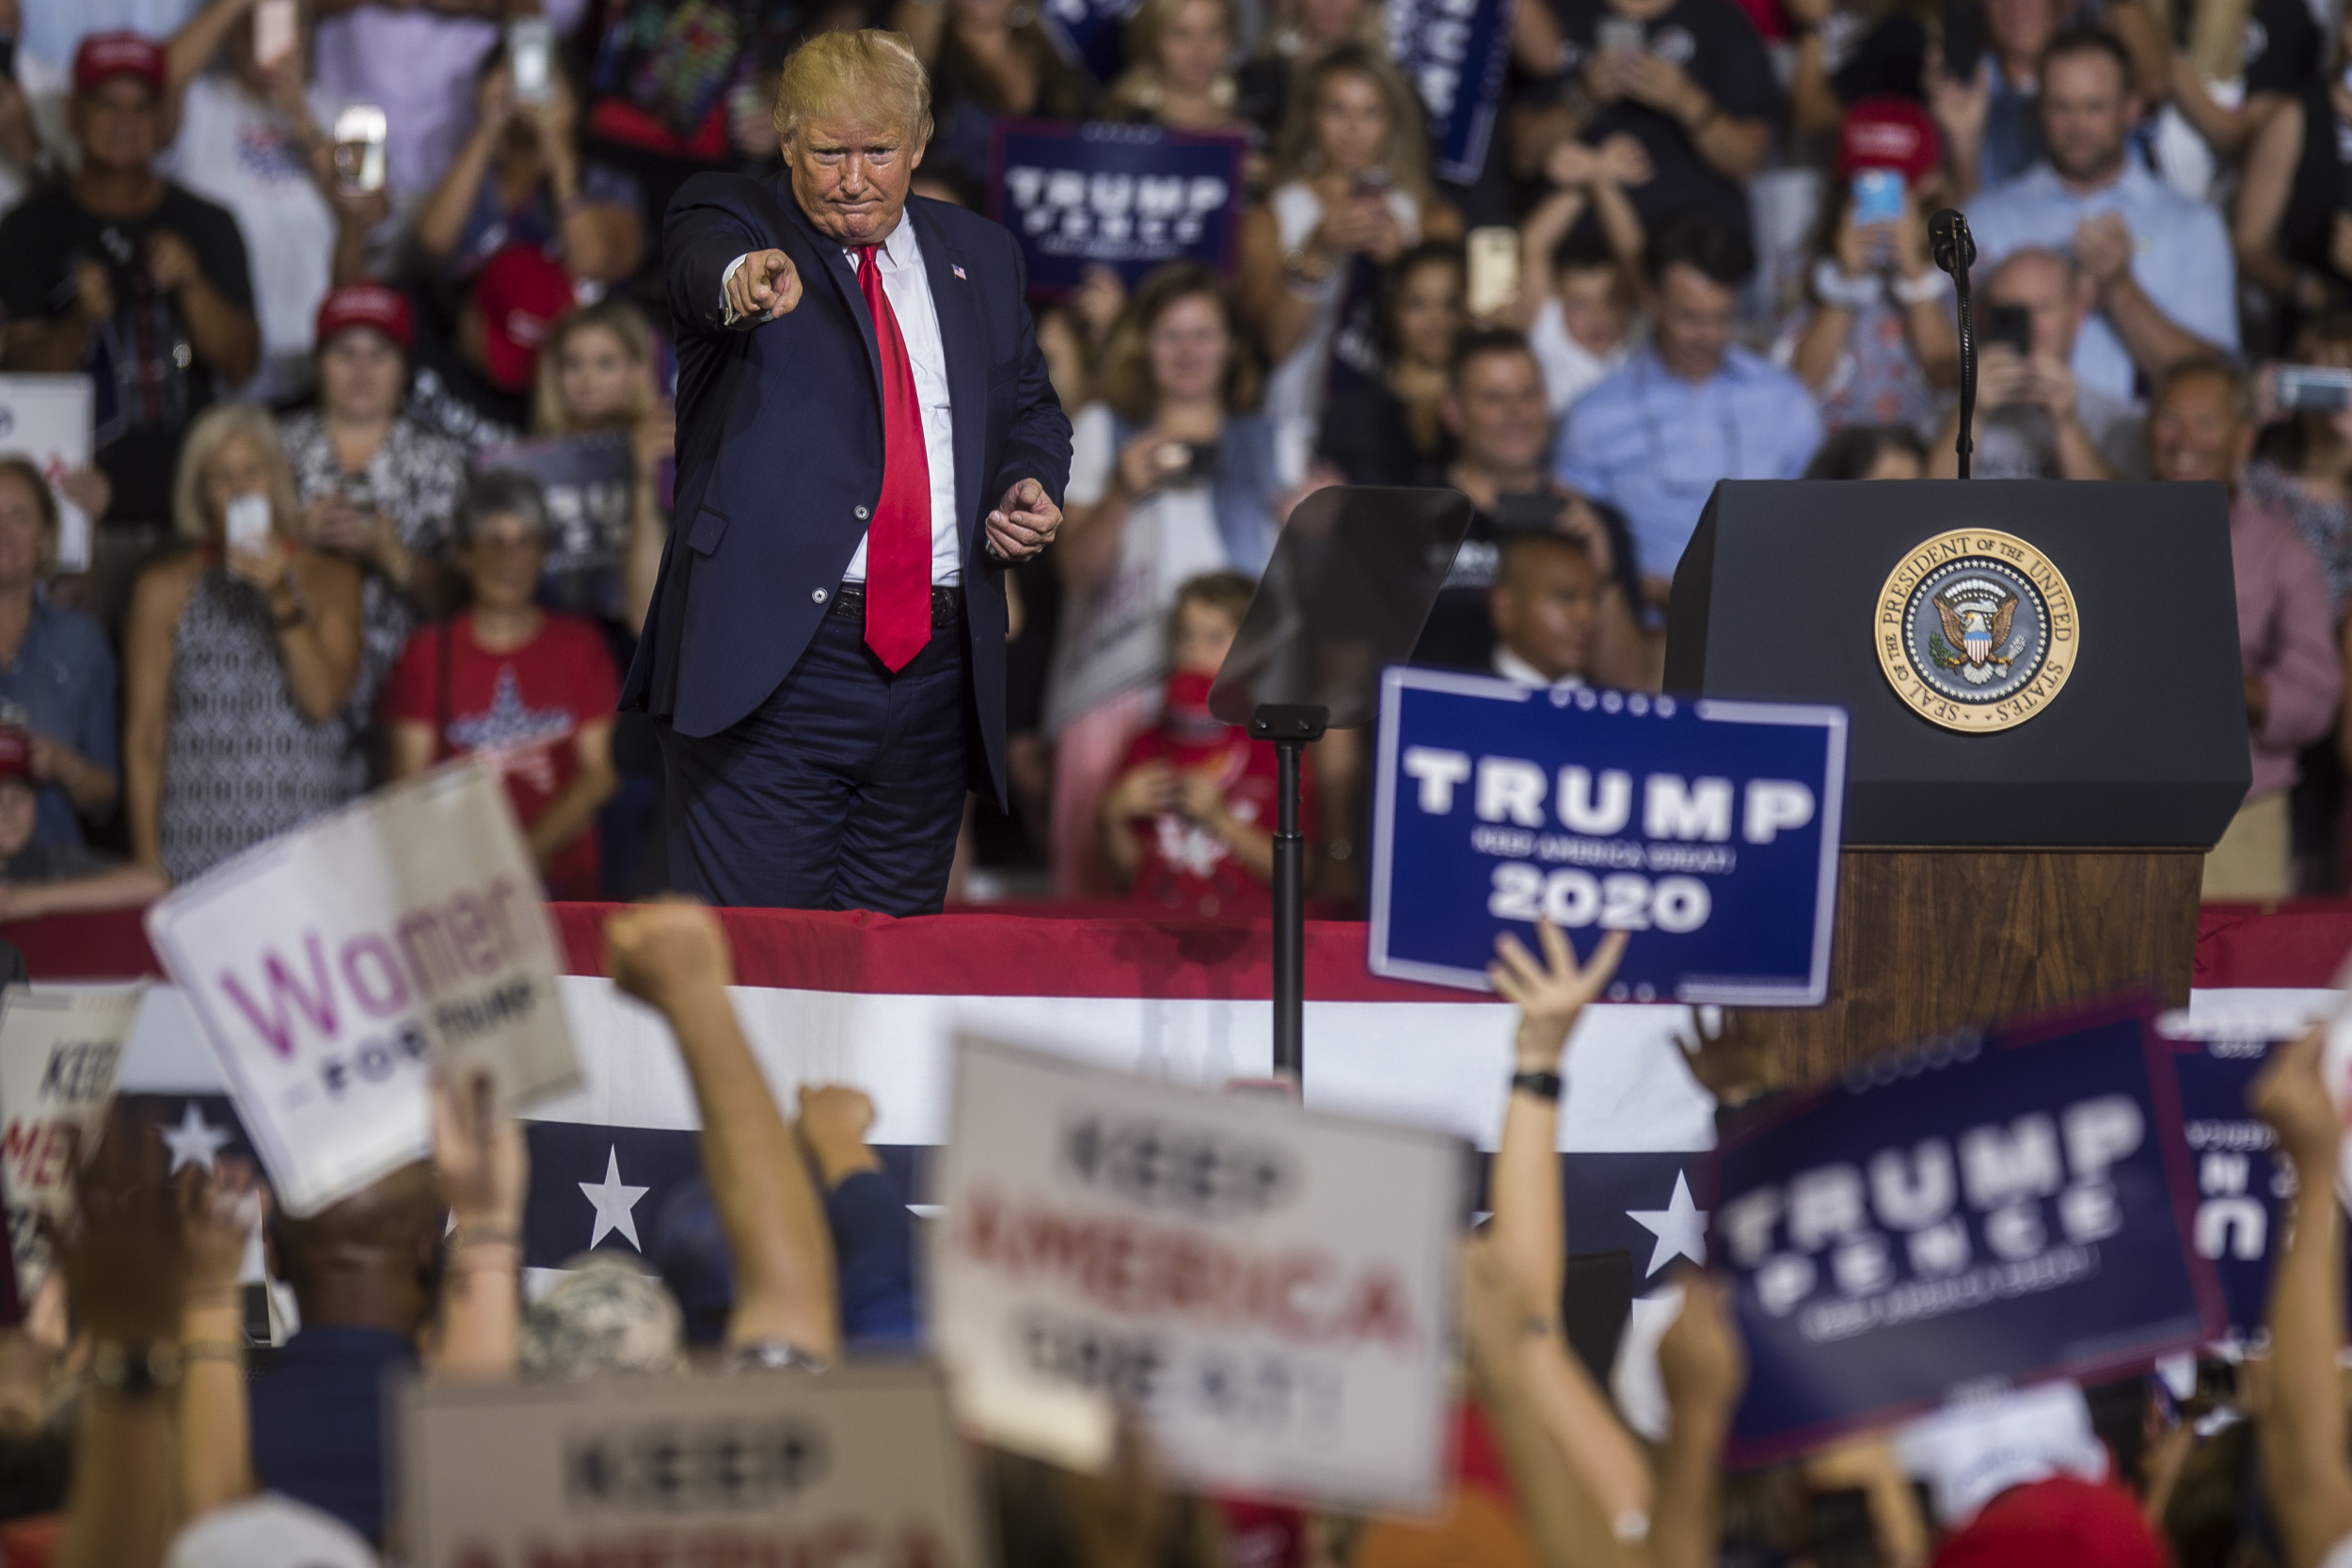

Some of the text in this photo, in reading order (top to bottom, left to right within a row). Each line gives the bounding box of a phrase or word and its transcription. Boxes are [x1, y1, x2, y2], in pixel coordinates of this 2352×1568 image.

[1006, 166, 1228, 218] TRUMP
[1883, 537, 2072, 721] SEAL OF THE PRESIDENT OF THE UNITED STATES
[1403, 744, 1816, 845] TRUMP
[1487, 861, 1712, 932] 2020
[320, 1018, 429, 1097] FOR
[1720, 1094, 2145, 1269] TRUMP
[958, 1180, 1417, 1359] AMERICA
[1756, 1174, 2122, 1317] PENCE
